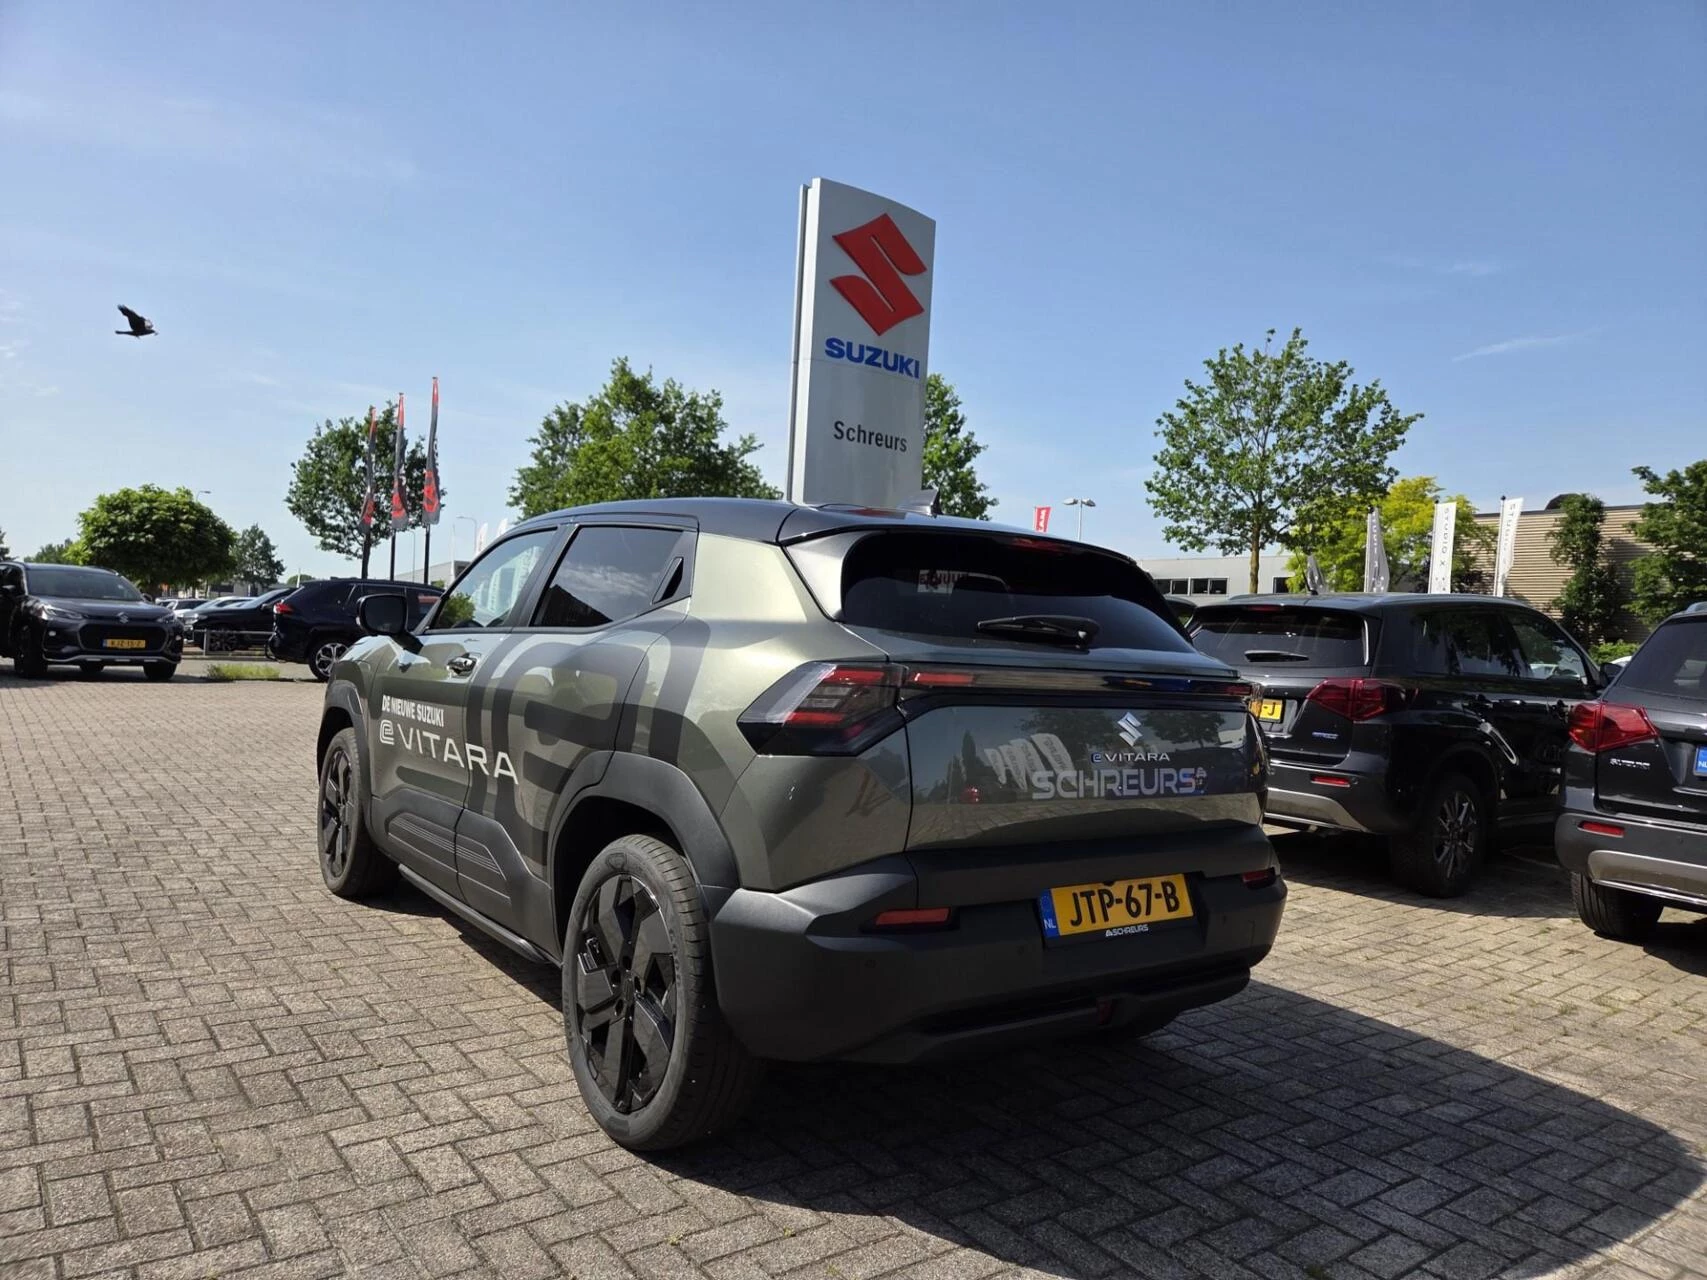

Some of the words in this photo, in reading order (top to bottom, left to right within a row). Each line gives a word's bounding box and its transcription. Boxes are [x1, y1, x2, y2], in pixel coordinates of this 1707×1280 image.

[825, 337, 920, 379] SUZUKI
[833, 420, 908, 452] Schreurs
[382, 694, 391, 713] DE
[391, 697, 416, 720] NIEUWE
[416, 703, 445, 728] SUZUKI
[1032, 767, 1196, 799] SCHREURS
[1070, 880, 1181, 927] JTP-67-B
[1043, 918, 1057, 930] NL
